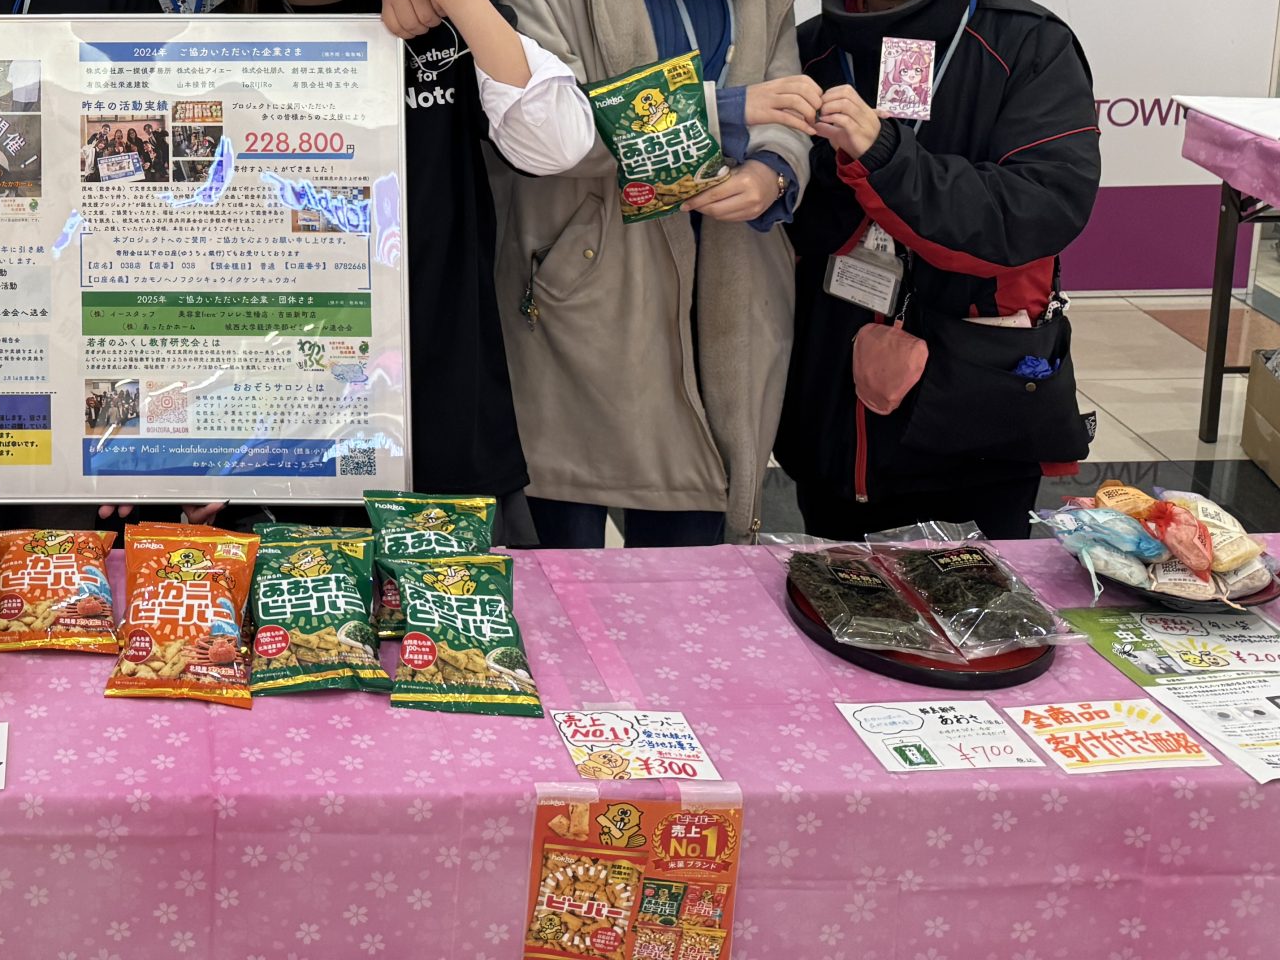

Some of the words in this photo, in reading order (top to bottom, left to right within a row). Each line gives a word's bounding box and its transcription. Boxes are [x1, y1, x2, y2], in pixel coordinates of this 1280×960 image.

[133, 46, 168, 58] 2024年
[180, 46, 302, 58] ご協力いただいた企業さま
[416, 69, 438, 82] for
[81, 100, 169, 112] 昨年の活動実績
[595, 95, 625, 109] hokka
[622, 138, 712, 179] ビーバー
[137, 295, 167, 304] 2025年
[86, 338, 221, 348] 若者のふくし教育研究会とは
[233, 383, 325, 392] おおぞらサロンとは
[169, 444, 289, 456] wakafuku.saitama@gmail.com
[375, 502, 406, 511] hokka
[134, 542, 164, 550] hokka
[27, 554, 77, 572] カニ
[0, 570, 101, 591] ビーバー
[158, 580, 211, 602] カニ
[130, 601, 234, 626] ビーバー
[258, 594, 366, 620] ビーバー
[407, 603, 514, 640] ビーバー
[564, 714, 605, 729] 売上
[634, 714, 685, 727] ビーバー
[939, 714, 982, 726] あおさ
[1020, 703, 1110, 730] 全商品
[1044, 729, 1203, 763] 寄付付き価格
[948, 742, 1014, 767] ¥700
[635, 756, 698, 777] ¥300
[676, 815, 717, 825] ビーバー
[671, 825, 701, 838] 売上
[545, 894, 624, 919] ビーバー
